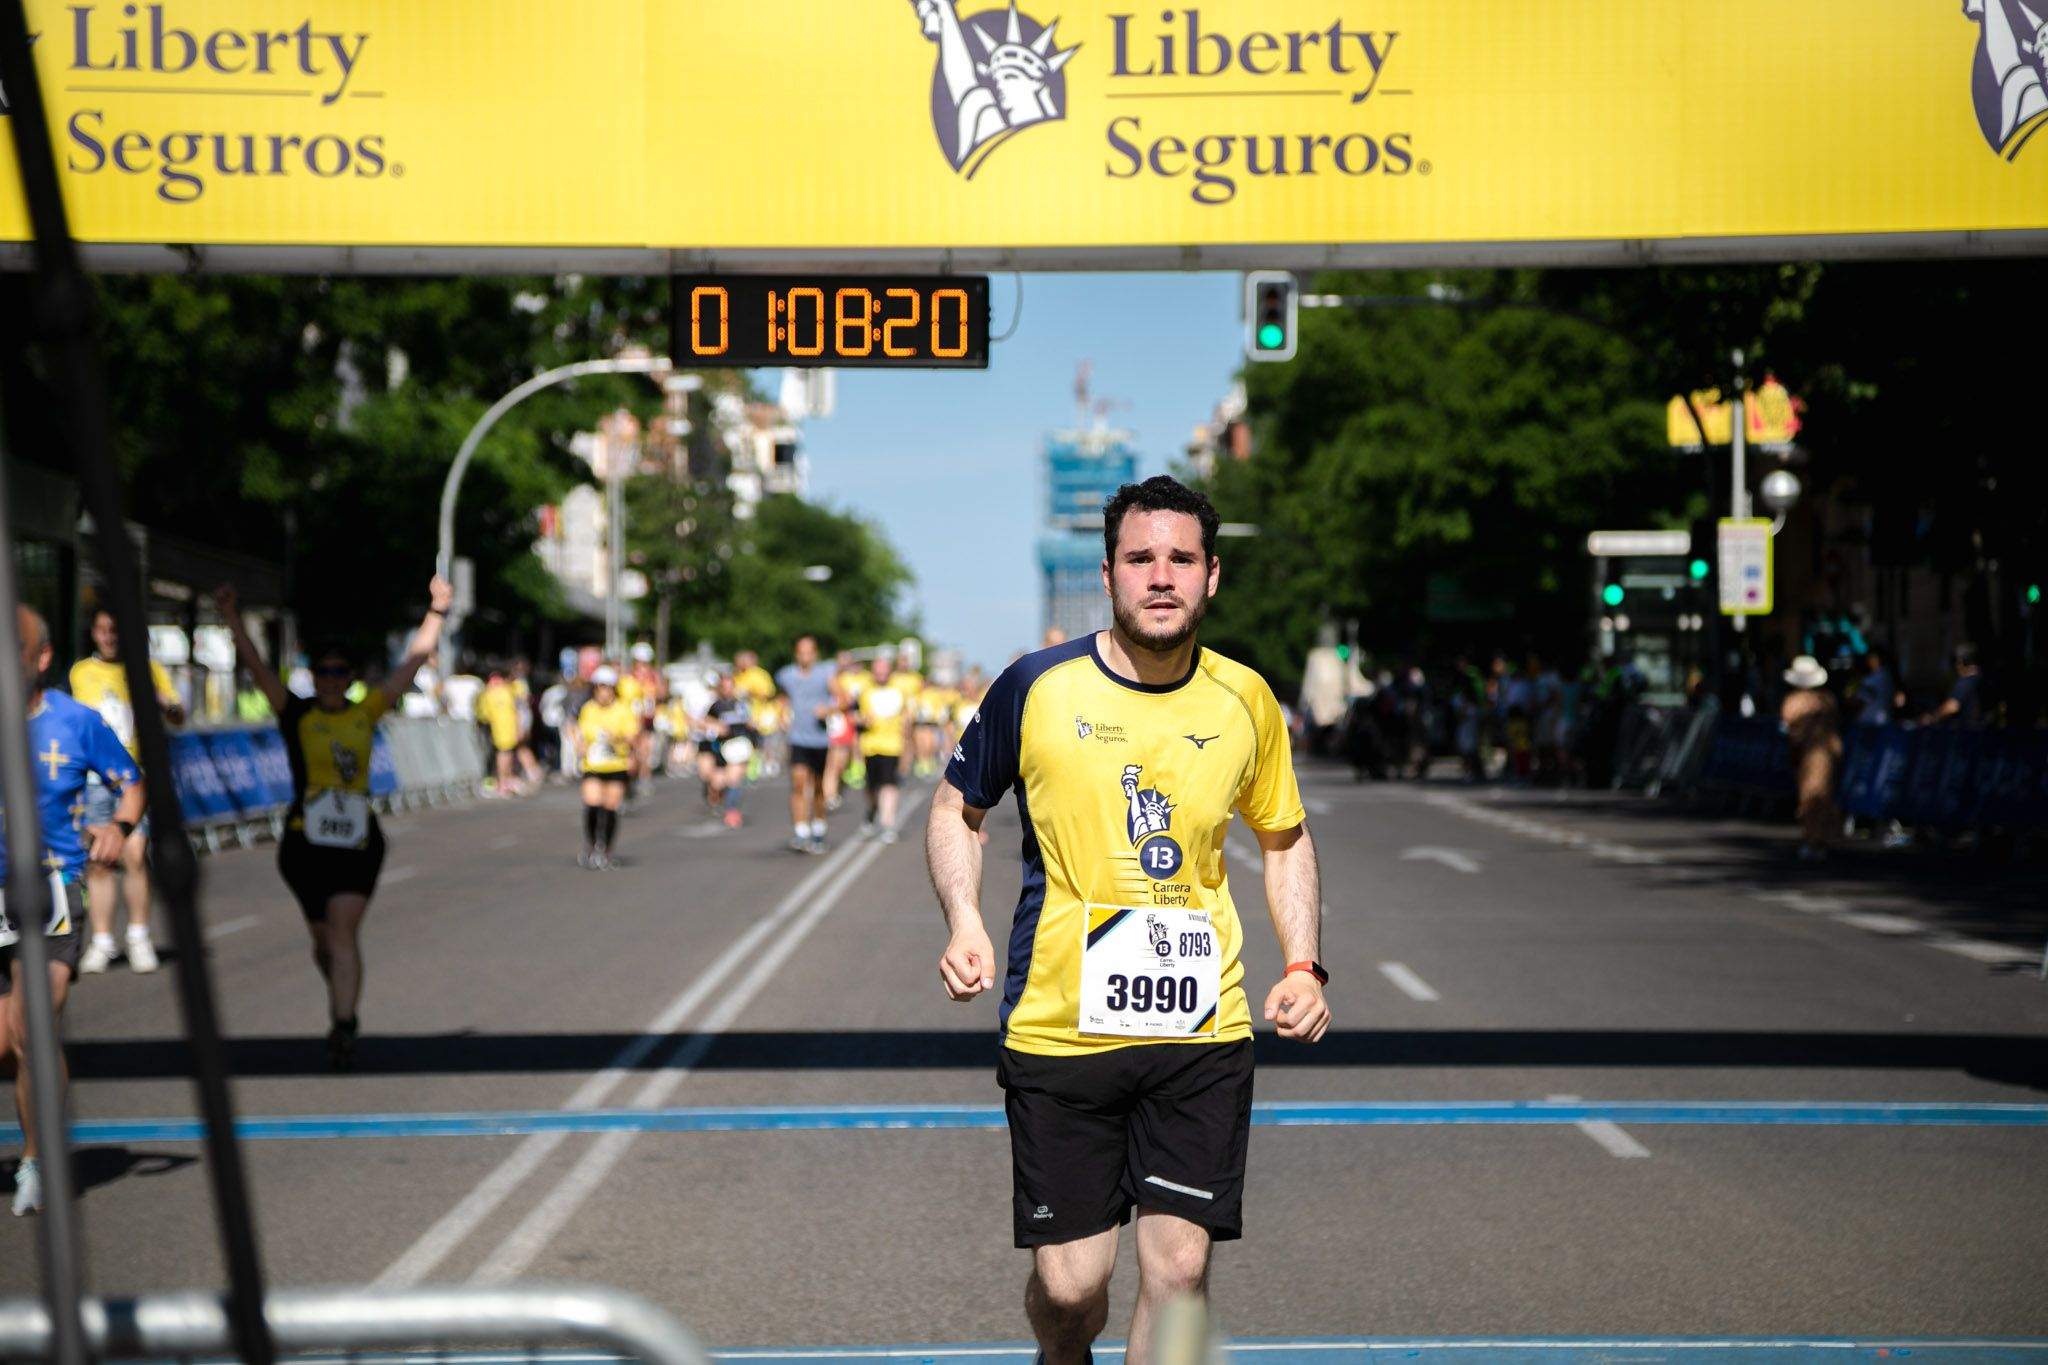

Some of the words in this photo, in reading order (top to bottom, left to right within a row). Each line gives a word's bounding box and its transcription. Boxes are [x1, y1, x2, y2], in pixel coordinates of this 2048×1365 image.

[67, 3, 370, 105] Liberty
[1107, 8, 1399, 105] Liberty
[67, 109, 386, 203] Seguros
[1106, 116, 1413, 205] Seguros
[1095, 723, 1124, 733] Liberty
[1148, 846, 1175, 869] 13
[1152, 882, 1191, 893] Carrera
[1153, 894, 1189, 907] Liberty
[1179, 932, 1212, 957] 8793
[1106, 973, 1198, 1014] 3990
